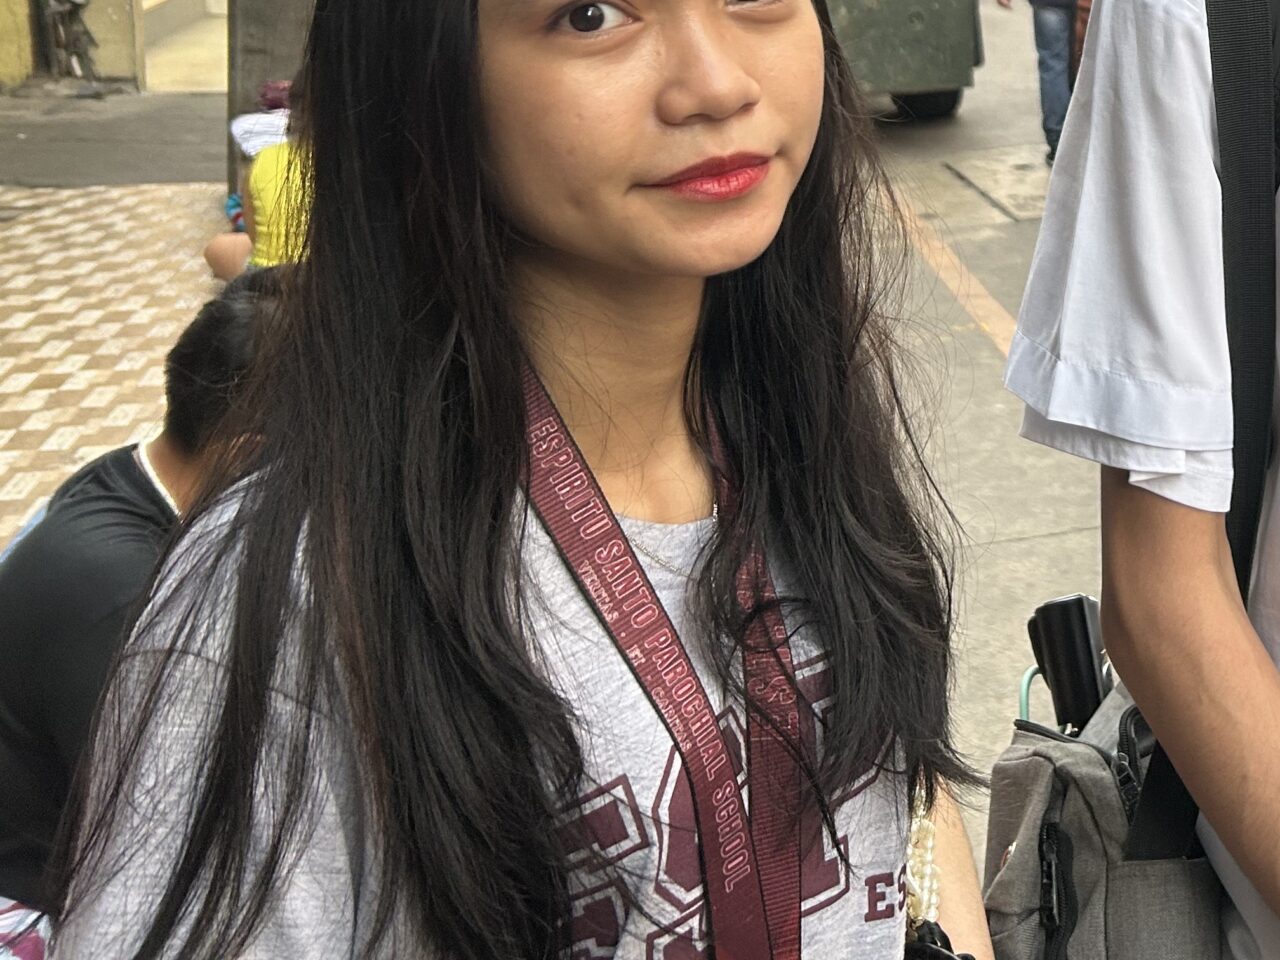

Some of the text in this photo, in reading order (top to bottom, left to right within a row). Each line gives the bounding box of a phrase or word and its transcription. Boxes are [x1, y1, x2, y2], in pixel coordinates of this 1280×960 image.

[530, 417, 751, 894] ESPIRITU SANTO PAROCHIAL SCHOOL
[578, 559, 692, 753] VERITAS ET CARITAS
